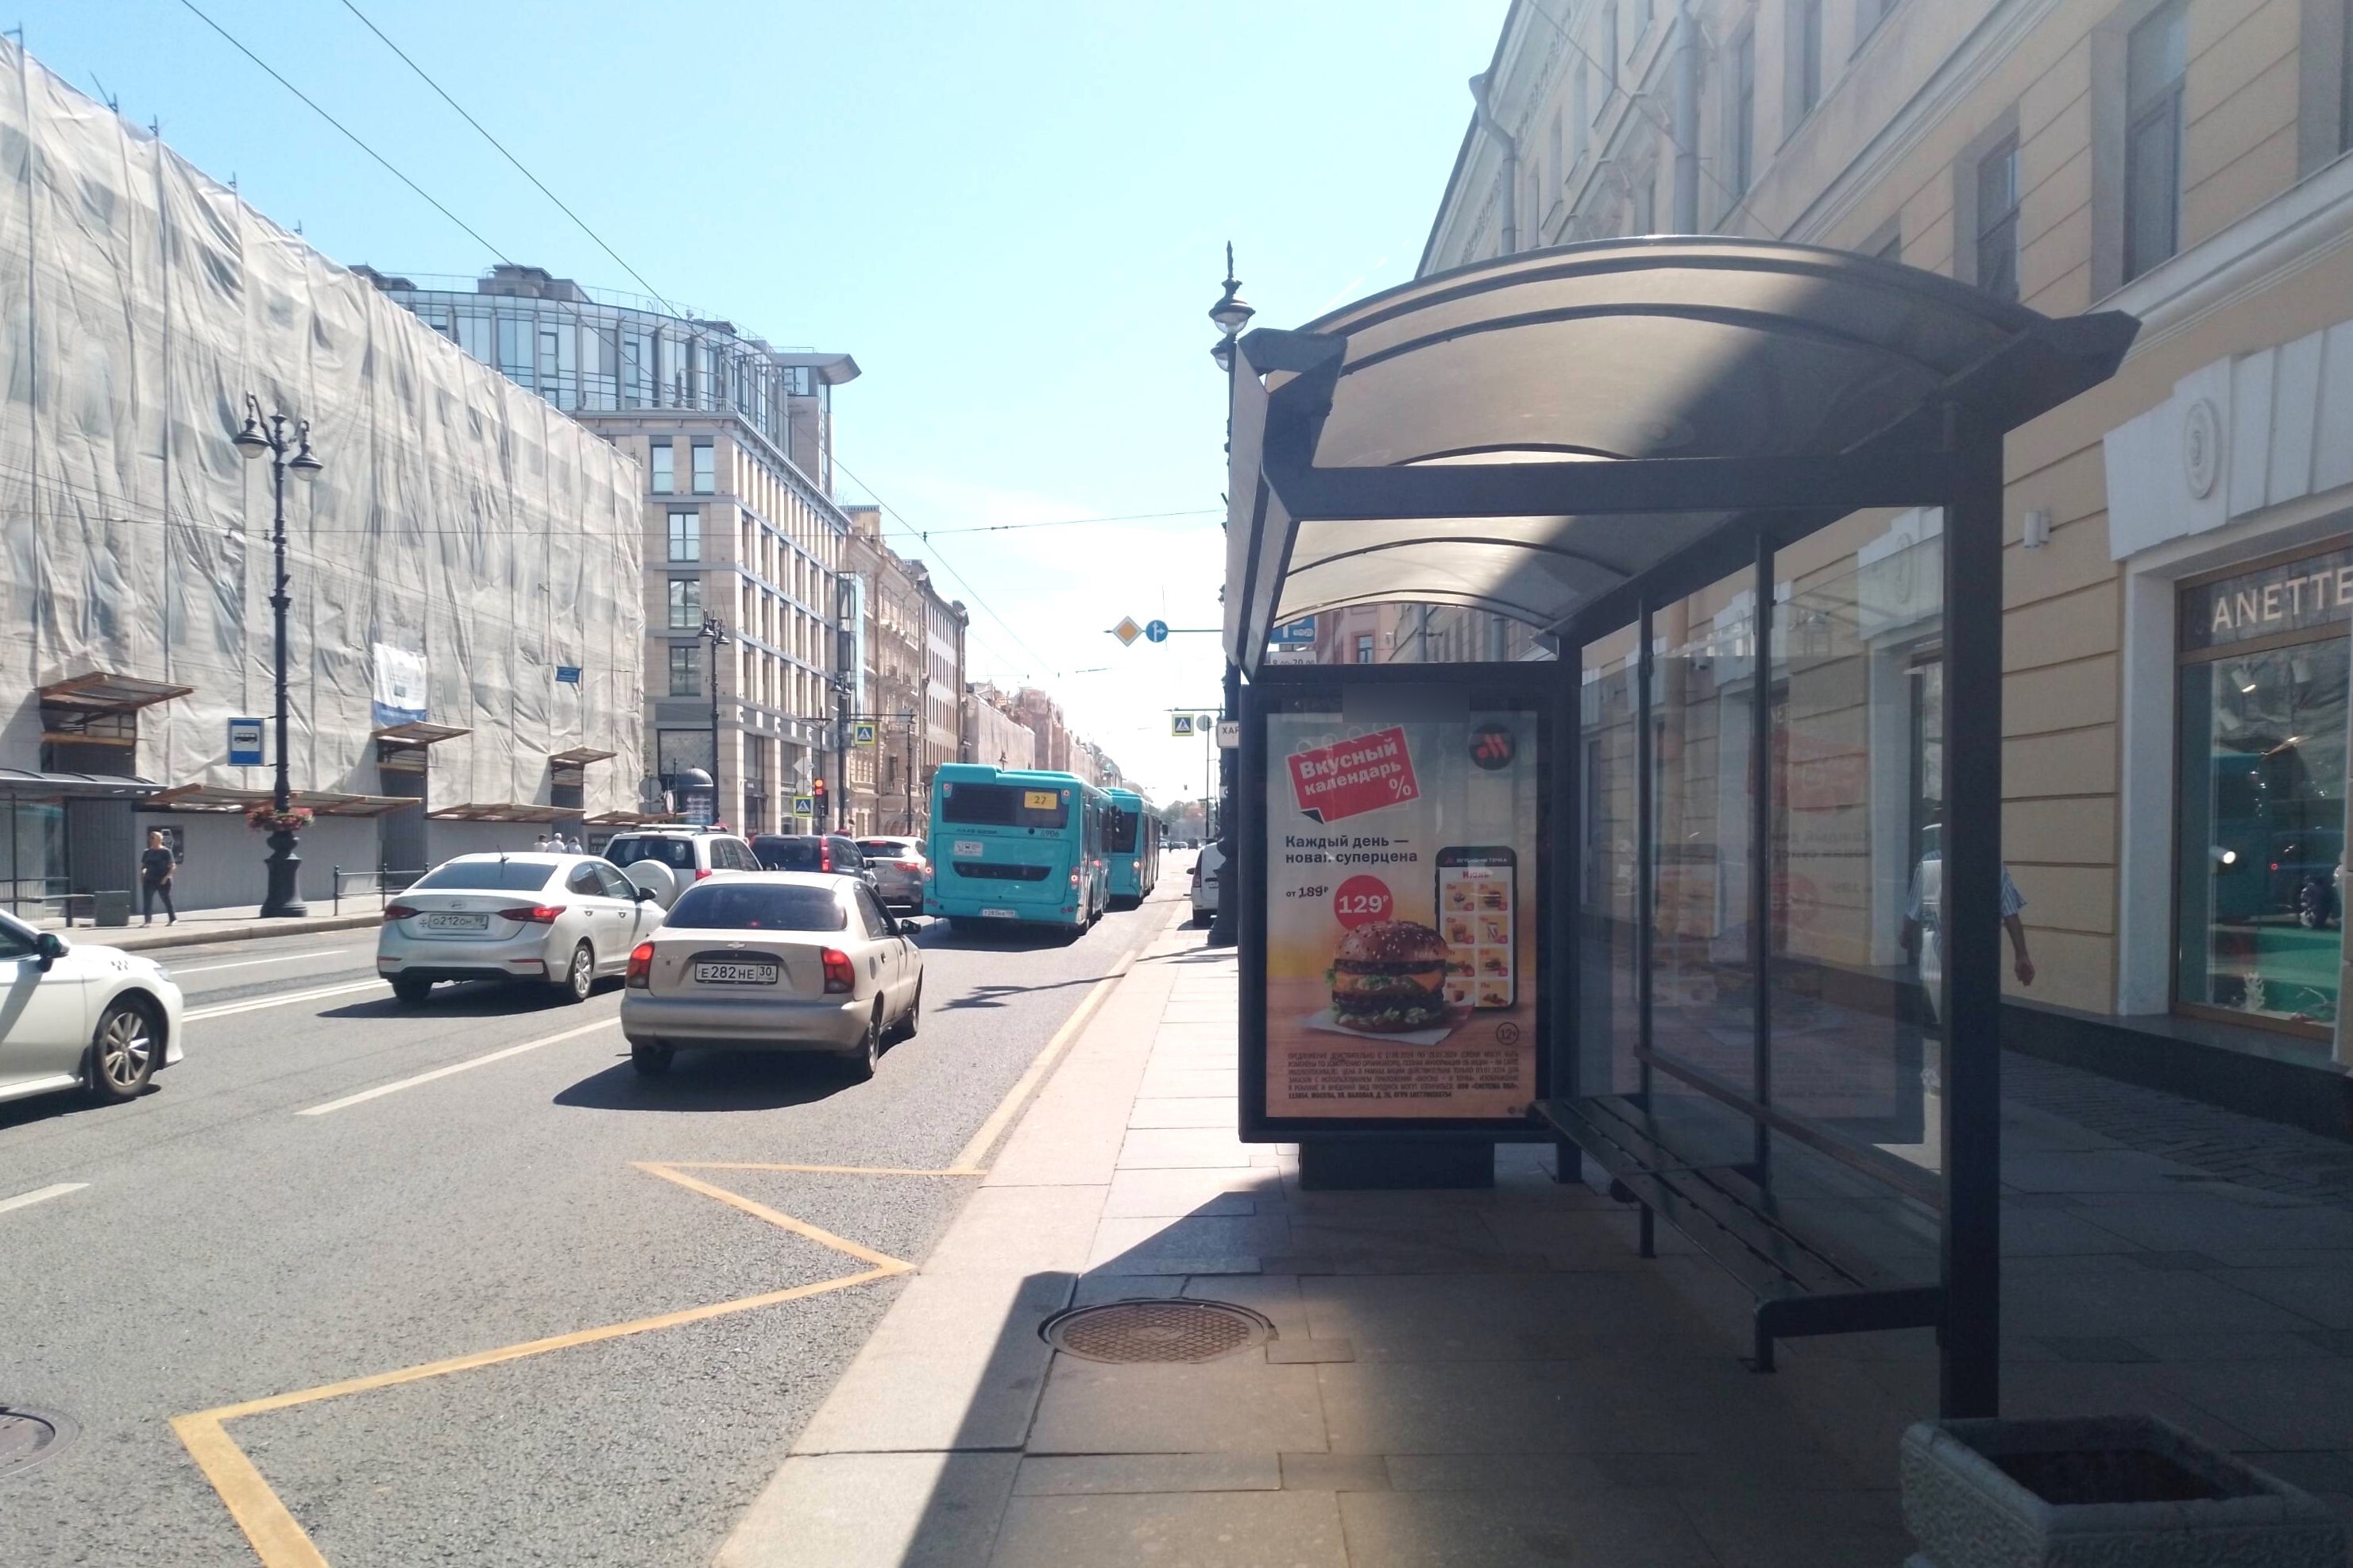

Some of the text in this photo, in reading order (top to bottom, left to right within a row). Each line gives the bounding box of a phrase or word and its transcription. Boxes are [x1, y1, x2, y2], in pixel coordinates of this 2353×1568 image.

[2212, 566, 2353, 632] ANETTE
[1300, 737, 1398, 779] Вкусный
[1304, 762, 1401, 795] календарь
[1034, 795, 1047, 805] 27
[1285, 835, 1348, 849] Каждый
[1353, 836, 1389, 848] день
[1335, 852, 1418, 865] суперцена
[701, 966, 772, 979] Е282НЕ 30
